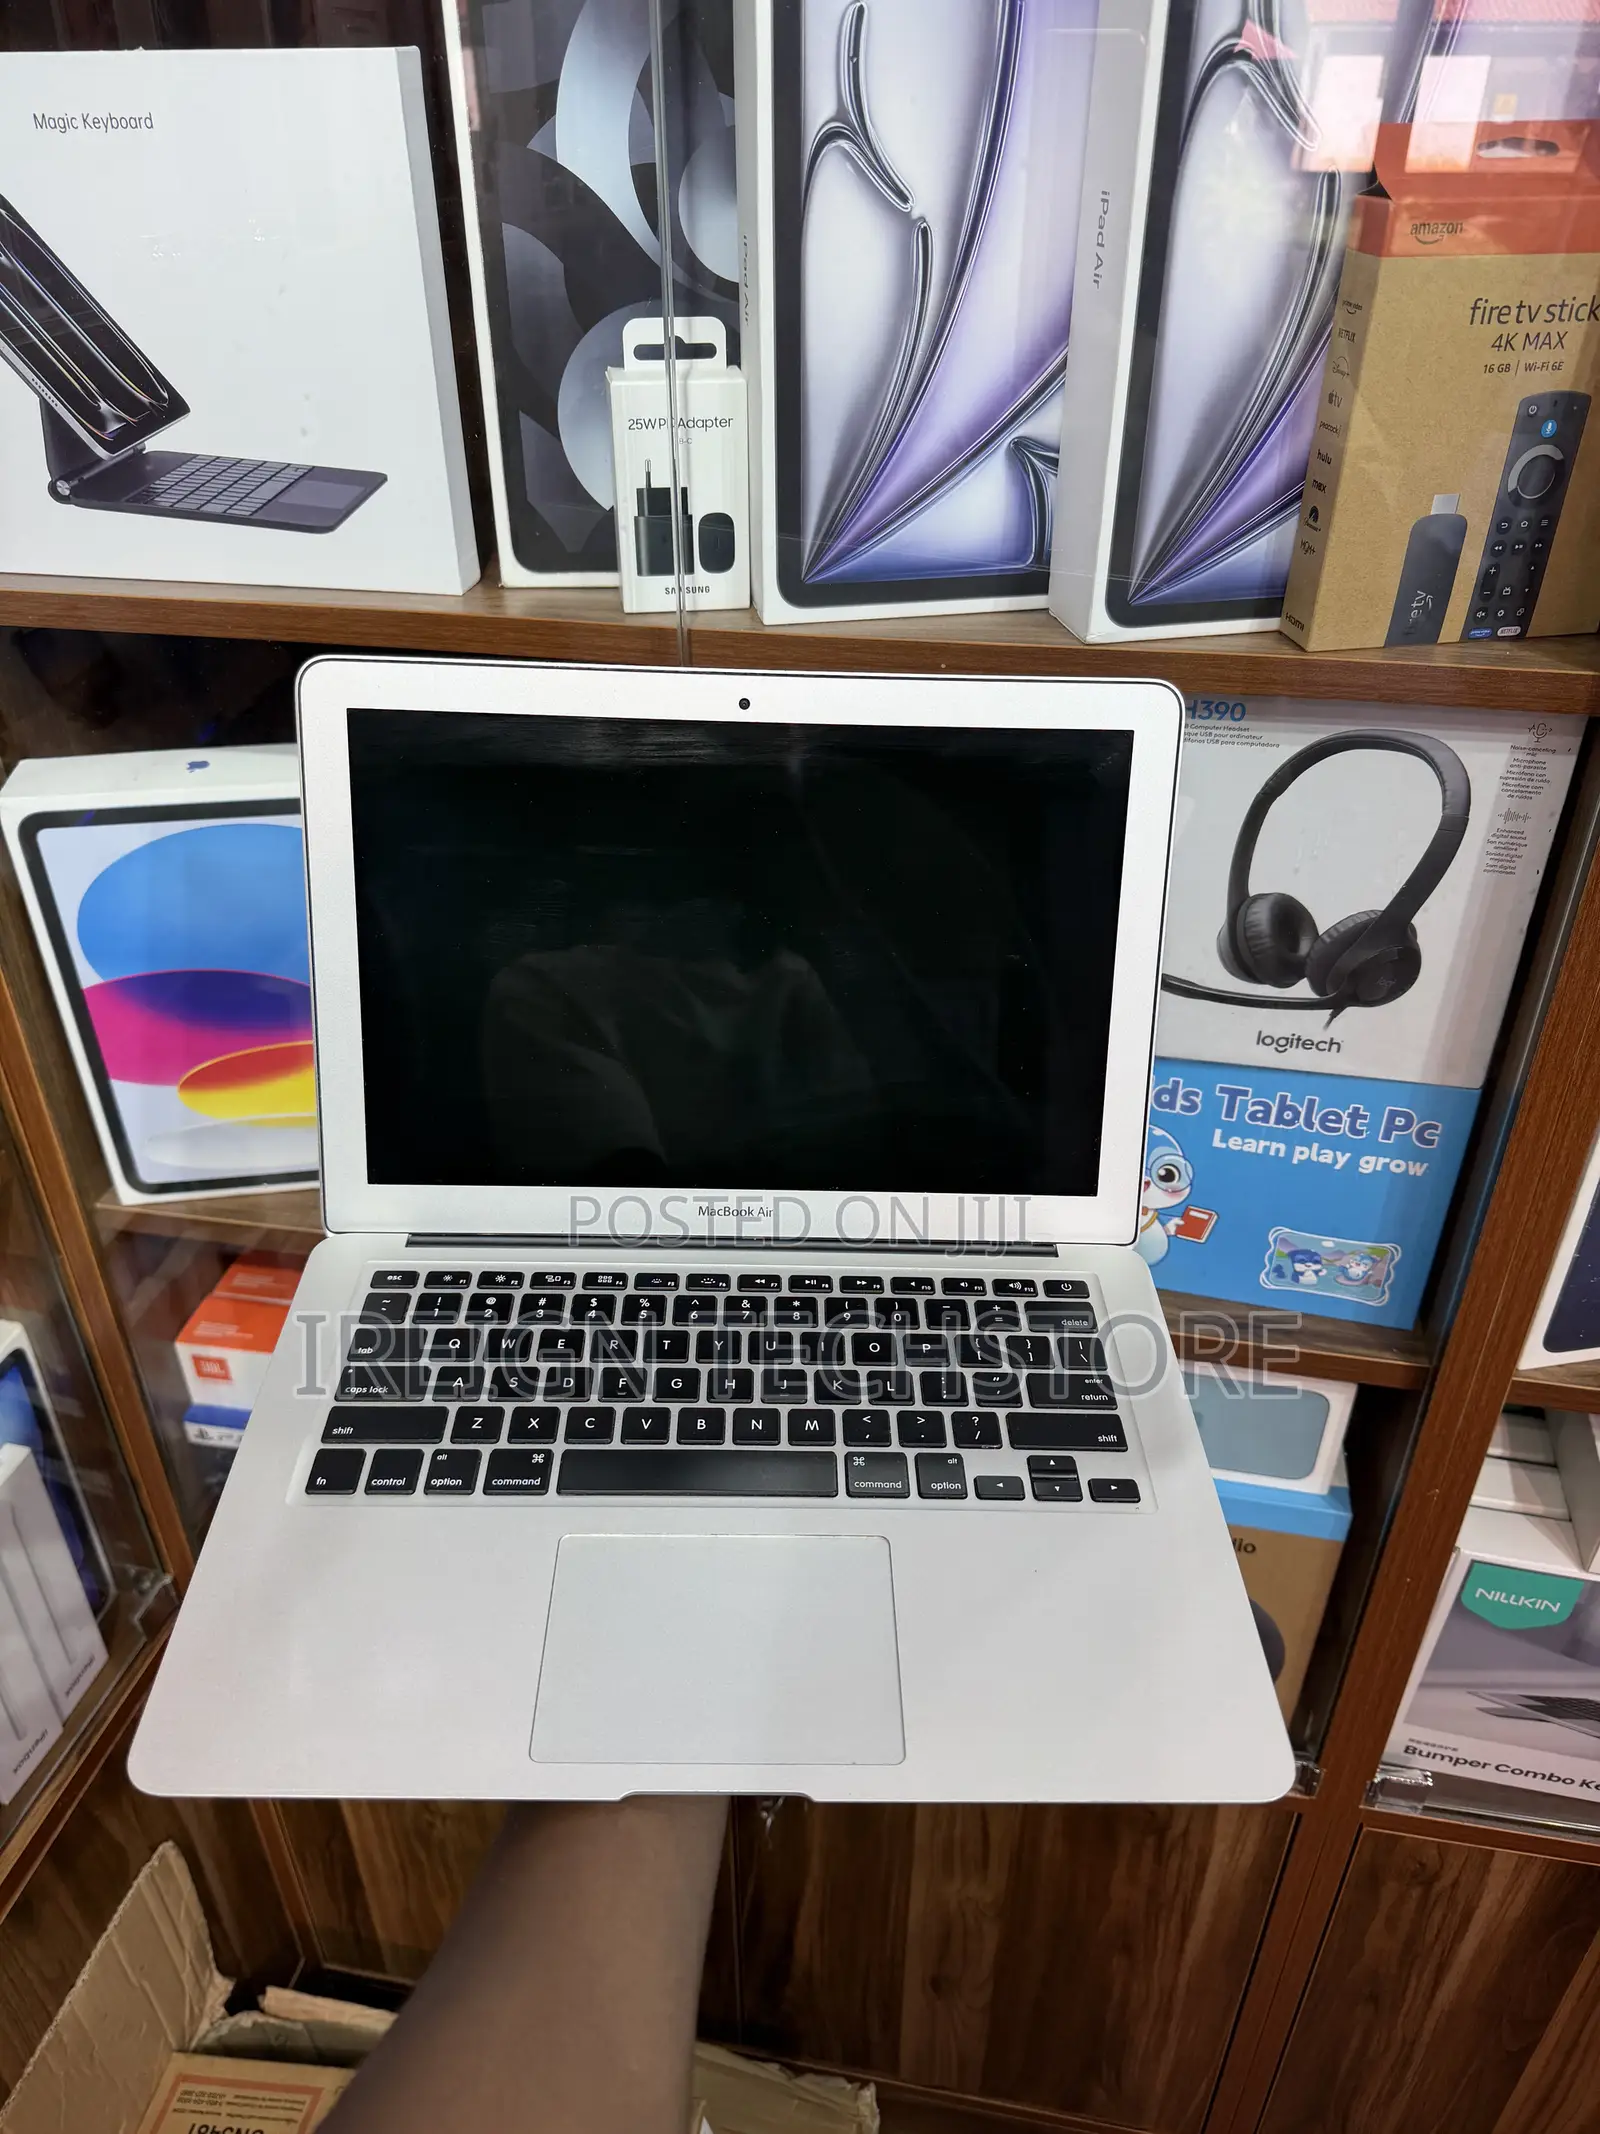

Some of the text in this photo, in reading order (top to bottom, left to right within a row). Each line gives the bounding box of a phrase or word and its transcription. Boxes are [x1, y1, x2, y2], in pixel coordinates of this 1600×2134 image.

[32, 112, 154, 134] Magic Keyboard
[1410, 221, 1464, 237] amazon
[1093, 190, 1110, 289] iPad Air
[1491, 331, 1568, 352] 4K MAX
[1483, 361, 1564, 374] 16 GB Wi-Fi 6E
[677, 417, 733, 432] Adapter
[1317, 449, 1332, 465] hulu
[1312, 479, 1327, 493] max
[1285, 611, 1304, 631] HDMI
[1185, 699, 1246, 722] H390
[1190, 724, 1221, 732] Computer
[1229, 733, 1263, 741] ordinateur
[1236, 741, 1280, 749] computadora
[1513, 758, 1546, 766] Microphone
[1256, 1030, 1342, 1053] logitech
[1151, 1078, 1442, 1148] ds Tablet Pc
[1212, 1128, 1428, 1176] Learn play grow
[698, 1205, 773, 1218] MacBook Air
[484, 1309, 492, 1317] 2
[588, 1310, 595, 1318] 4
[640, 1310, 647, 1318] 5
[691, 1311, 698, 1319] 6
[742, 1311, 749, 1319] 7
[793, 1312, 800, 1320] 8
[449, 1339, 460, 1348] Q
[502, 1339, 515, 1348] W
[558, 1340, 565, 1348] E
[610, 1340, 618, 1349] R
[663, 1341, 670, 1349] T
[715, 1341, 723, 1350] Y
[766, 1341, 776, 1350] U
[923, 1344, 930, 1353] P
[345, 1385, 367, 1394] caps
[453, 1377, 463, 1387] A
[509, 1377, 518, 1387] S
[563, 1378, 573, 1387] D
[619, 1378, 627, 1387] F
[672, 1379, 682, 1388] G
[725, 1379, 735, 1389] H
[781, 1380, 786, 1389] J
[833, 1380, 842, 1390] K
[887, 1381, 894, 1391] L
[1081, 1393, 1108, 1401] return
[472, 1418, 483, 1428] Z
[528, 1418, 539, 1428] X
[585, 1418, 595, 1428] C
[642, 1419, 651, 1429] V
[698, 1419, 706, 1429] B
[752, 1420, 762, 1429] N
[805, 1420, 819, 1430] M
[431, 1478, 462, 1486] option
[931, 1482, 961, 1490] option
[1475, 1587, 1561, 1613] NILLKIN
[1403, 1744, 1491, 1767] Bumper
[1495, 1763, 1575, 1785] Combo
